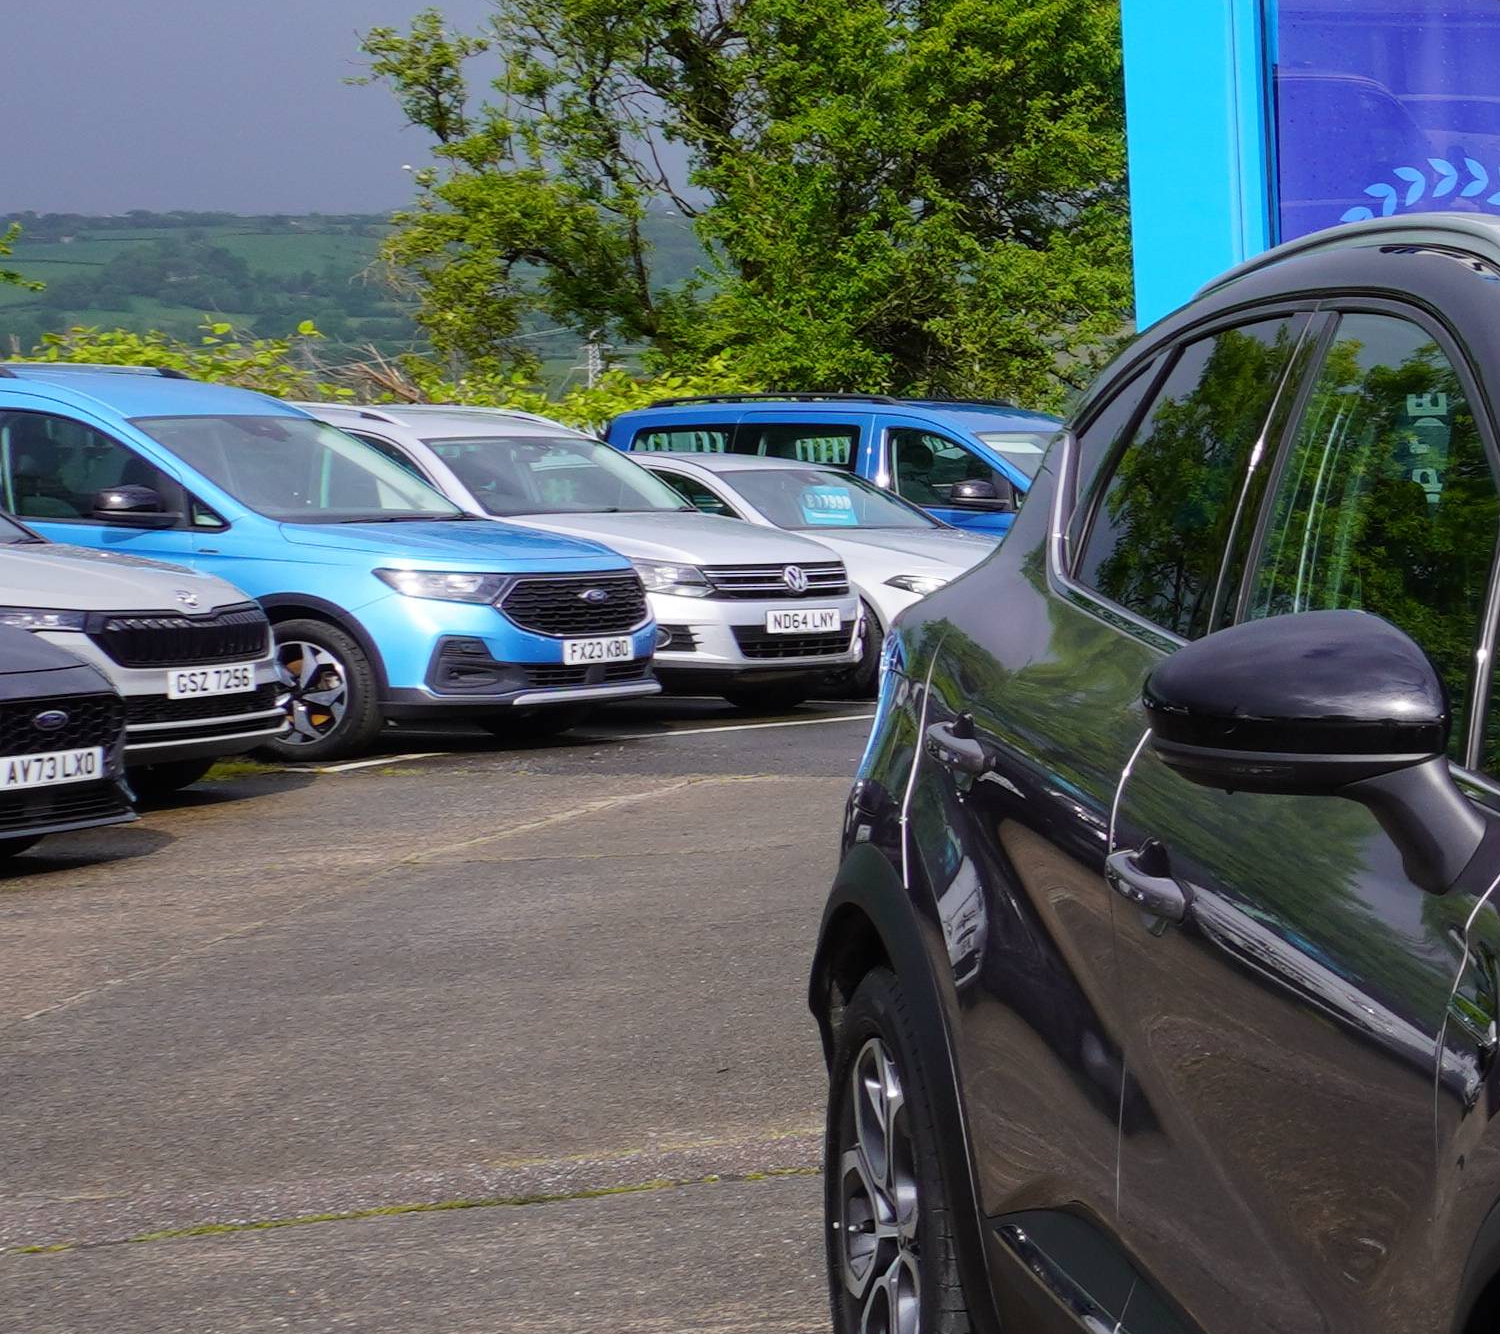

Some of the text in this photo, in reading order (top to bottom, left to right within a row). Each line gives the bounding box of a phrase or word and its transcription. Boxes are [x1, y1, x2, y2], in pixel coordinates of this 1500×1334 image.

[773, 611, 835, 629] ND64 LNY
[570, 642, 604, 661] FX23
[177, 667, 250, 694] GSZ 7256
[7, 752, 95, 784] AV73 LXO
